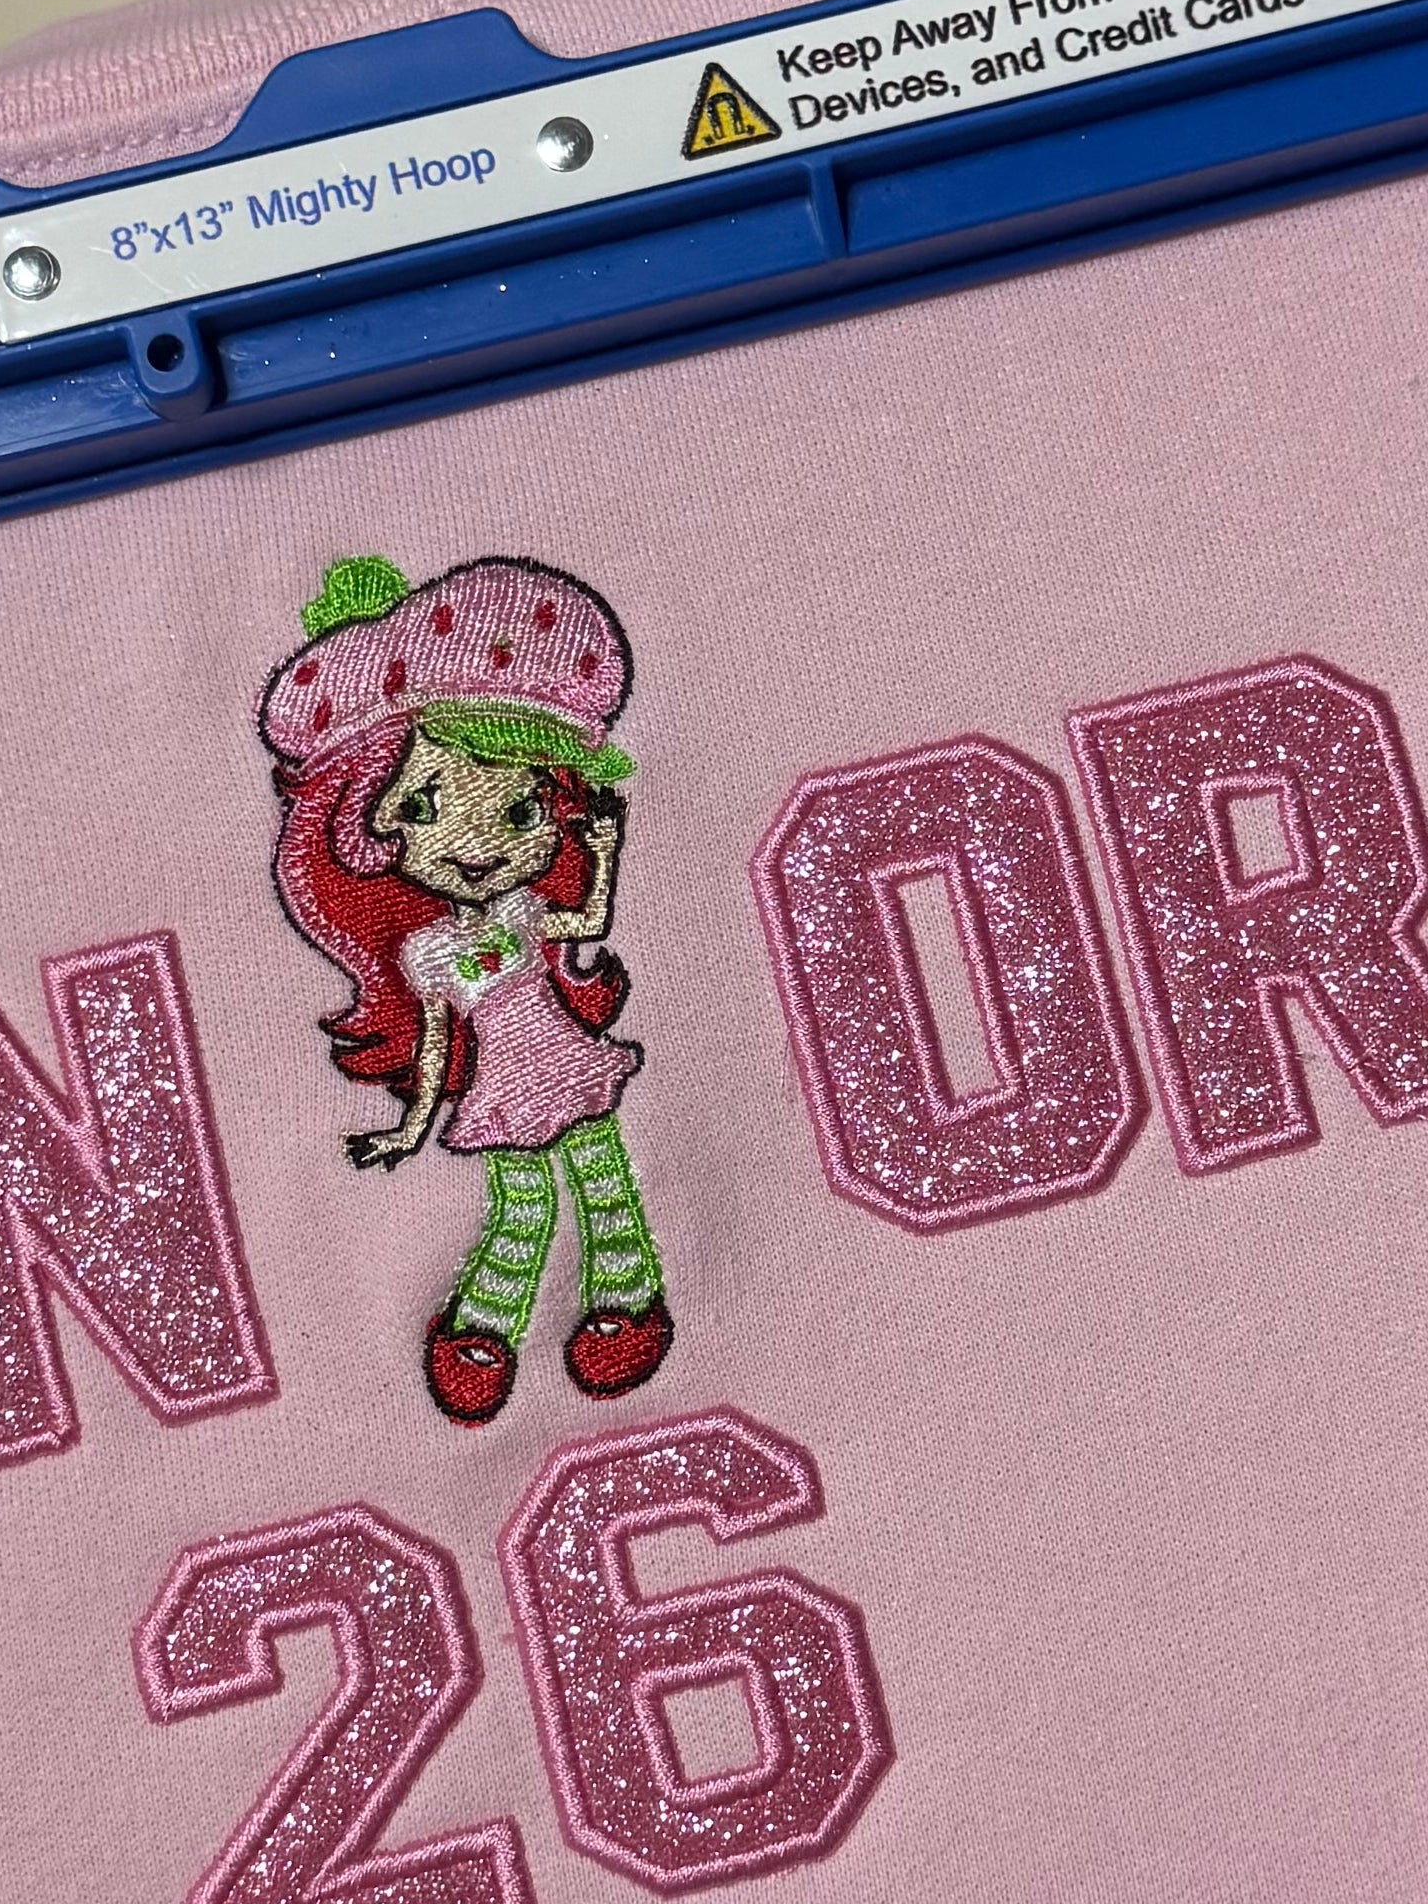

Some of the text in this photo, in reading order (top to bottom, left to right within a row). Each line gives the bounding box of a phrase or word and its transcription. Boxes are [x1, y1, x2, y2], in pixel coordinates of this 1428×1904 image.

[776, 36, 882, 87] Keep
[892, 2, 996, 56] Away
[789, 69, 961, 131] Devices,
[970, 39, 1045, 87] and
[1054, 7, 1177, 65] Credit
[247, 173, 378, 229] Mighty
[388, 146, 496, 198] Hoop
